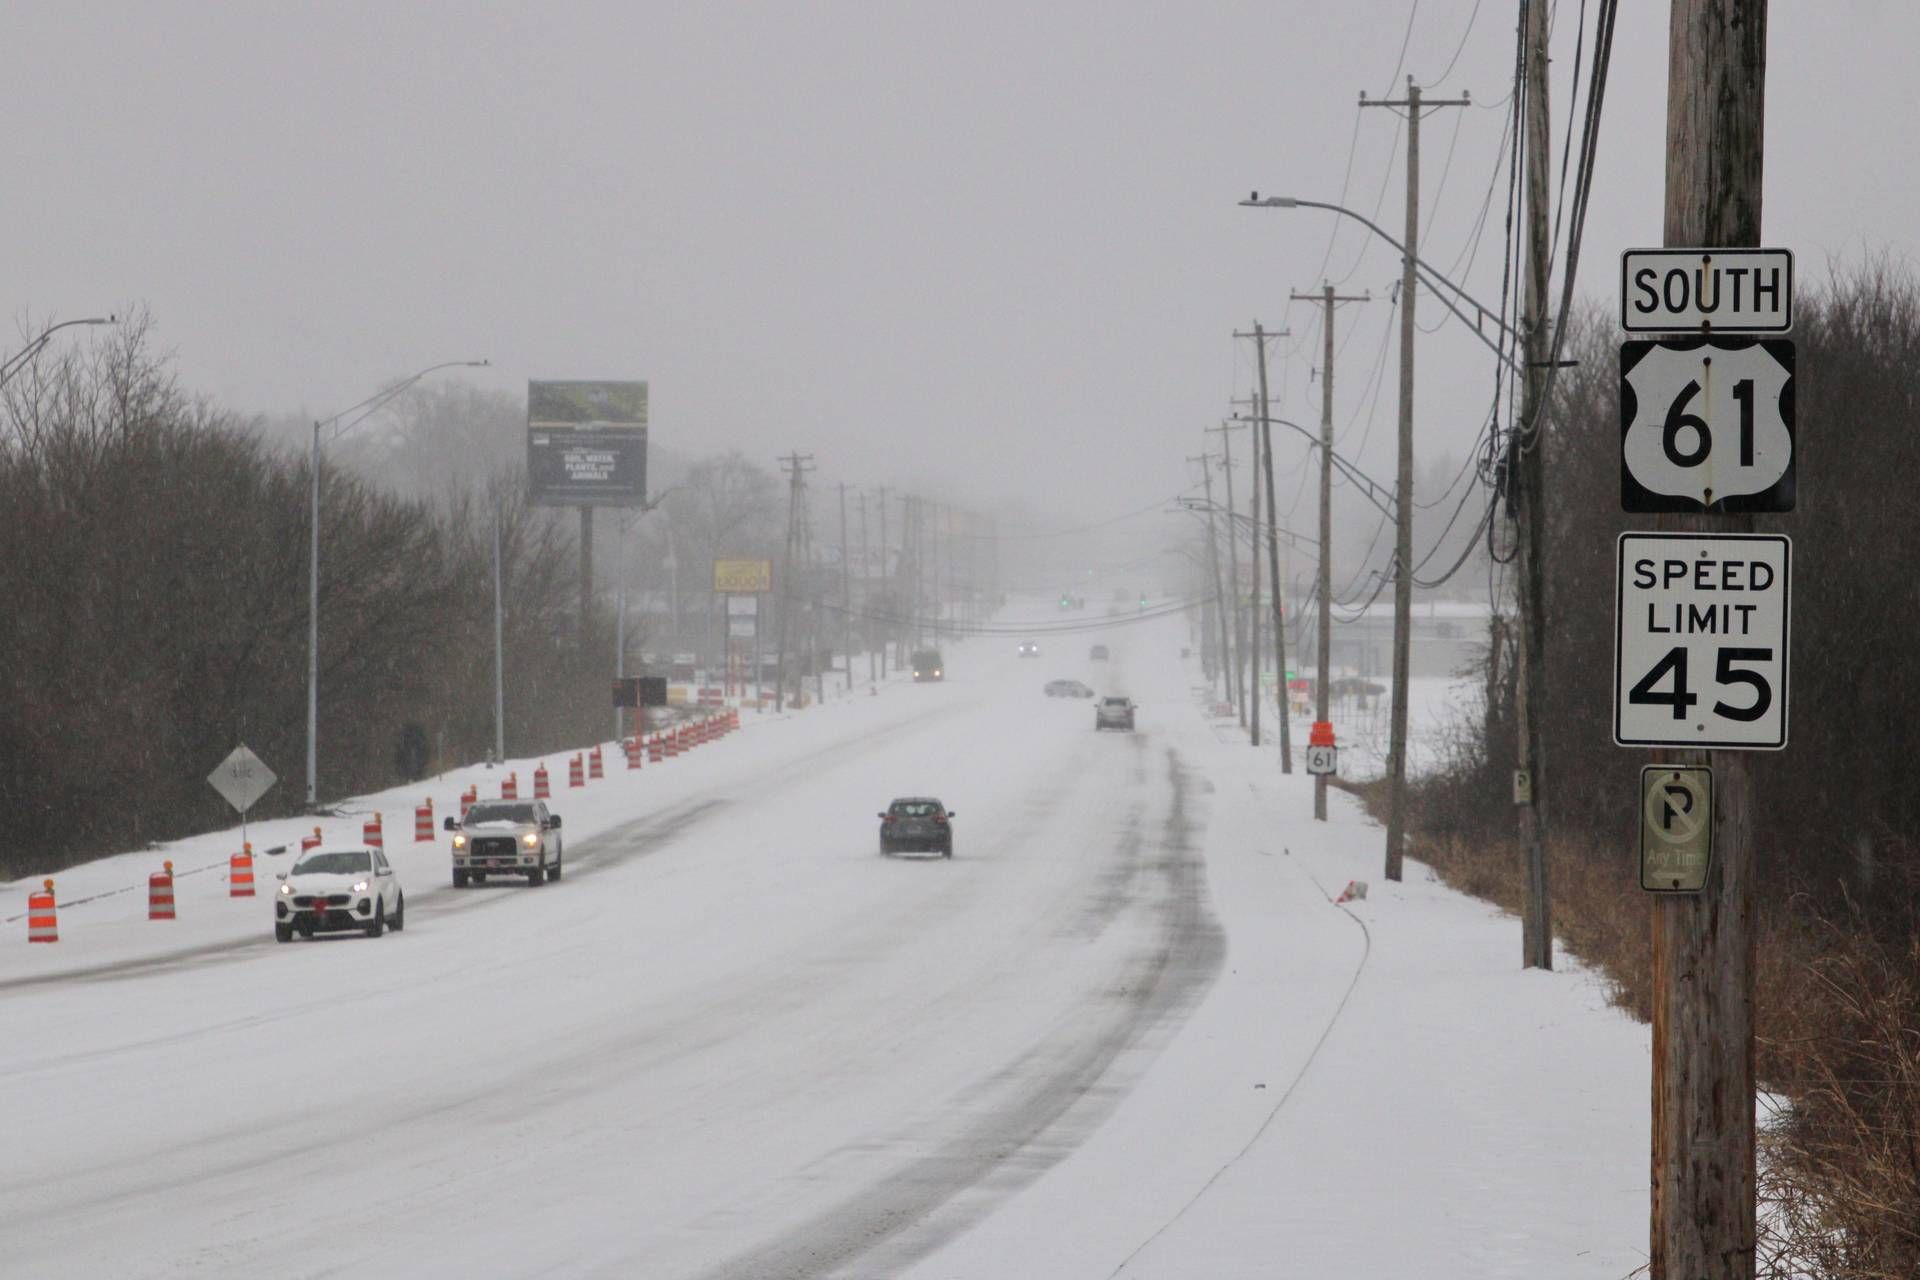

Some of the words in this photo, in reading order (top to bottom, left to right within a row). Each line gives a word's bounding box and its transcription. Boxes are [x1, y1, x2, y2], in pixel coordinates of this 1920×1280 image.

[1634, 268, 1780, 314] SOUTH
[1662, 378, 1754, 468] 61
[1633, 558, 1775, 592] SPEED
[1648, 602, 1757, 635] LIMIT
[1628, 646, 1773, 722] 45
[1313, 752, 1331, 767] 61
